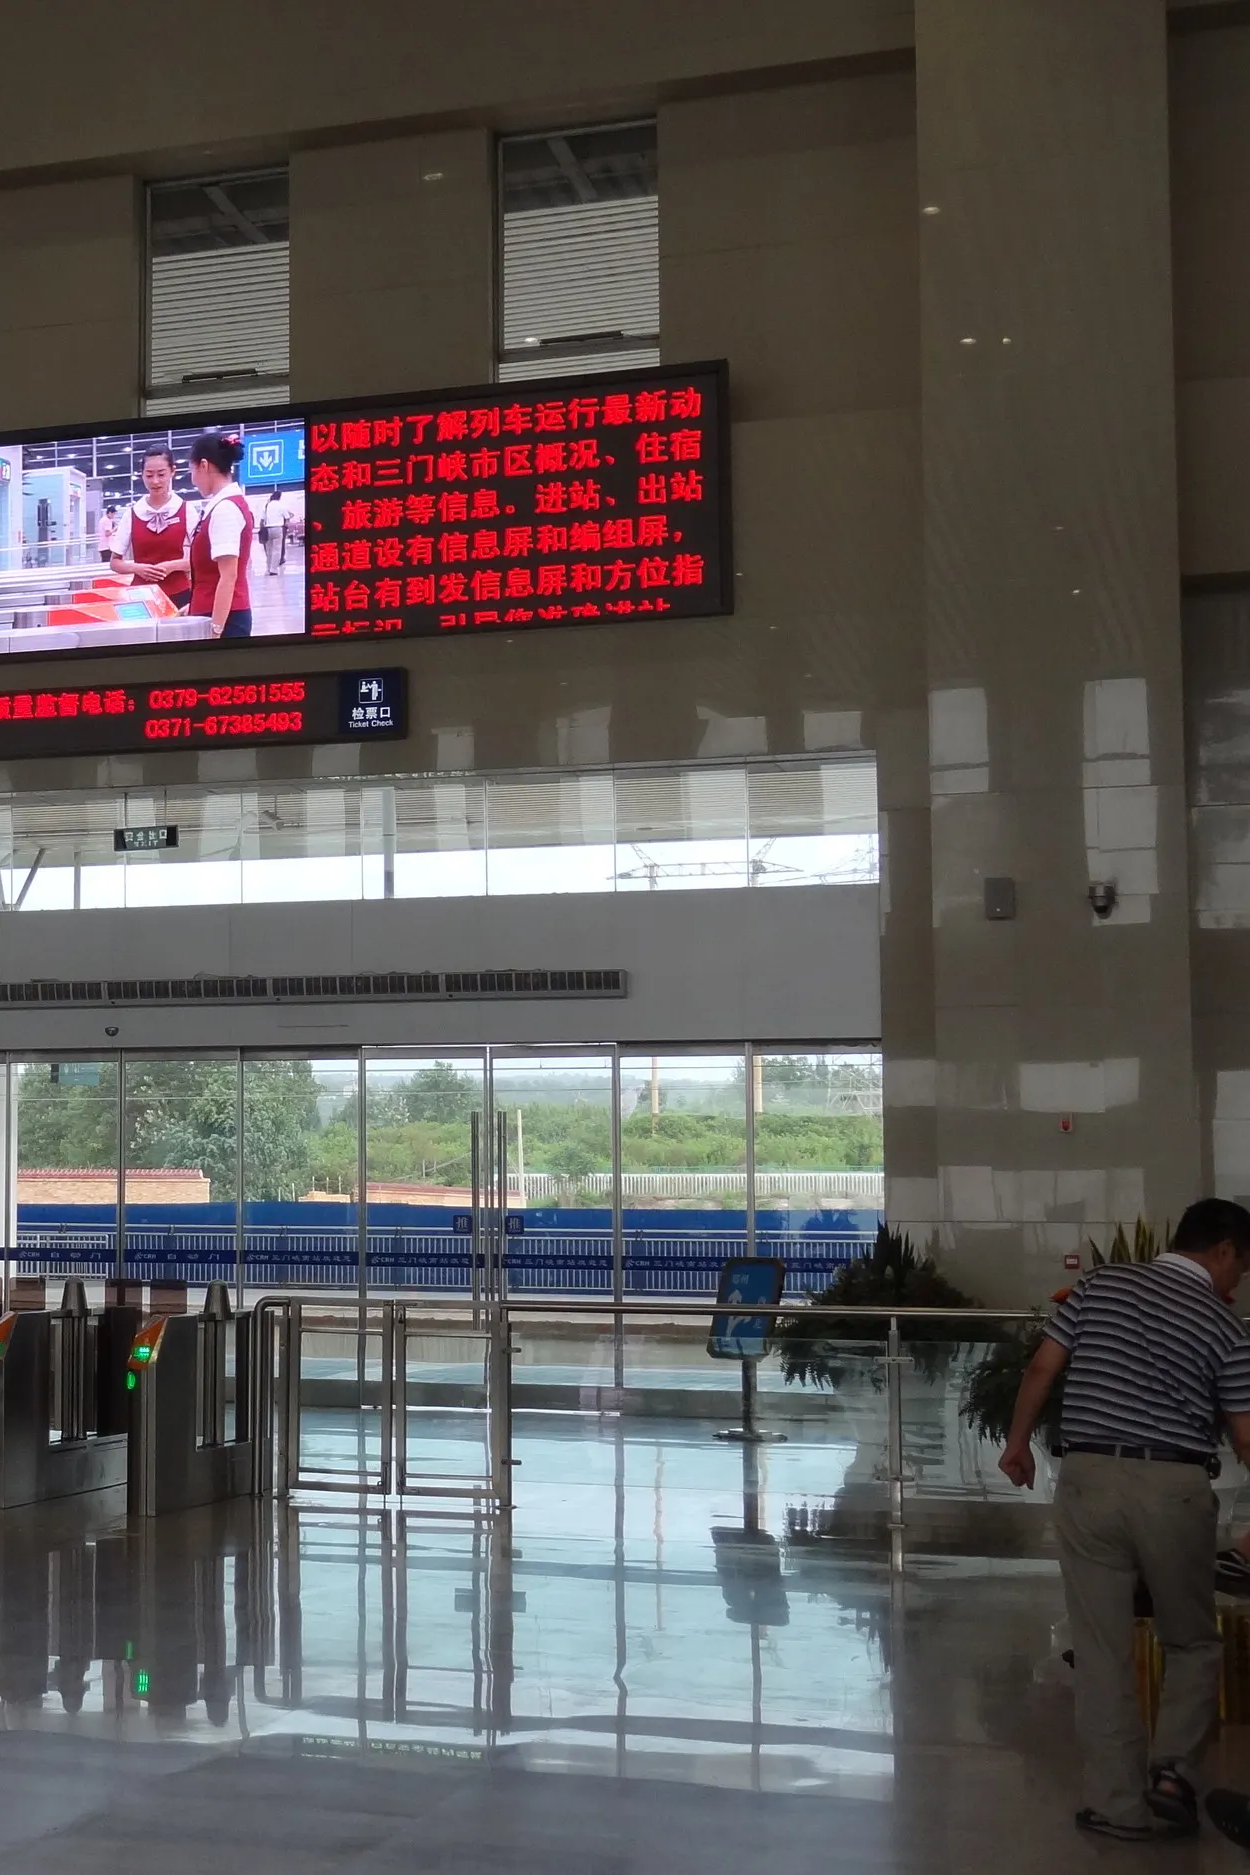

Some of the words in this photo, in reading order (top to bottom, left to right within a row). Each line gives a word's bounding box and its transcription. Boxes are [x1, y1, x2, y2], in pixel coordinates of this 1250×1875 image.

[311, 387, 702, 453] 以随时了解列车运行最新动
[310, 429, 702, 493] 态和三门峡市区概况、住宿
[311, 469, 703, 532] 、旅游等信息。进站、出站
[310, 514, 684, 573] 通道设有信息屏和编组屏，
[310, 555, 704, 613] 站台有到发信息屏和方位指
[149, 681, 306, 710] 0379-62561555
[348, 720, 369, 728] Ticket
[371, 719, 394, 727] Check
[352, 706, 391, 720] 检票口
[144, 711, 303, 739] 0371-67385493
